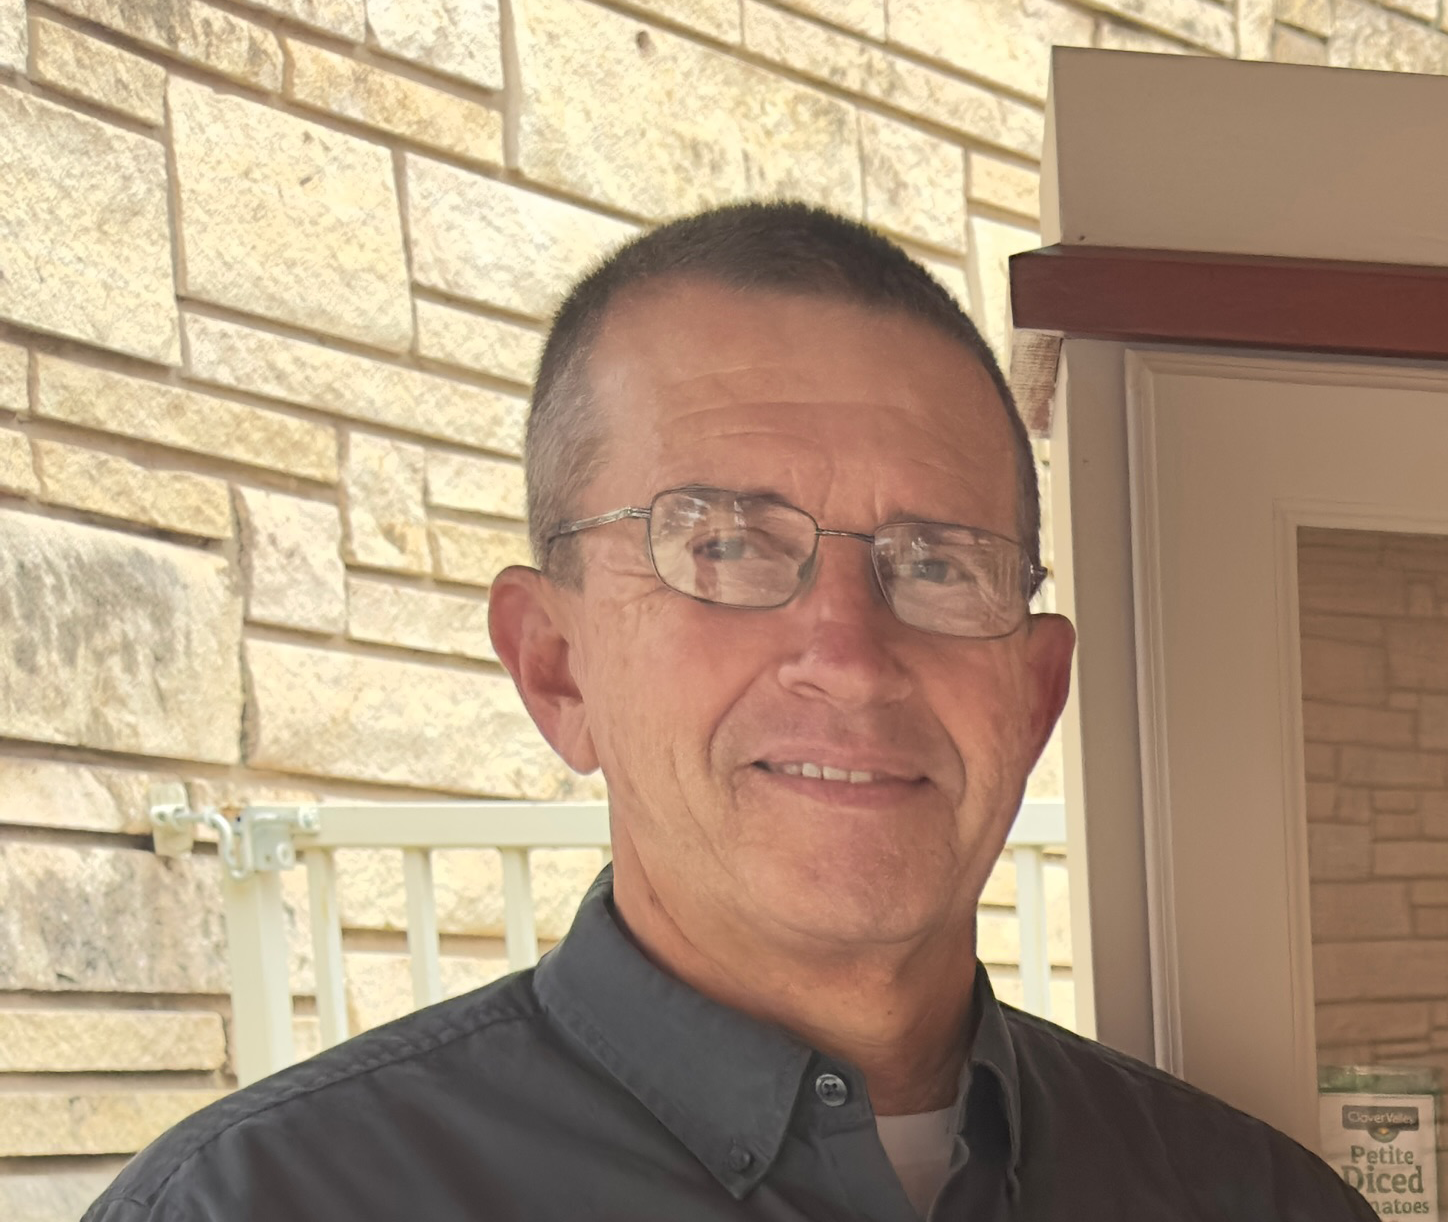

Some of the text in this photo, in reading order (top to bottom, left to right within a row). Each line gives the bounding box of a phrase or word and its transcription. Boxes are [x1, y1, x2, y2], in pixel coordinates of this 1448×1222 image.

[1347, 1110, 1416, 1125] Clover Valley
[1351, 1145, 1414, 1165] Petite
[1341, 1165, 1424, 1194] Diced
